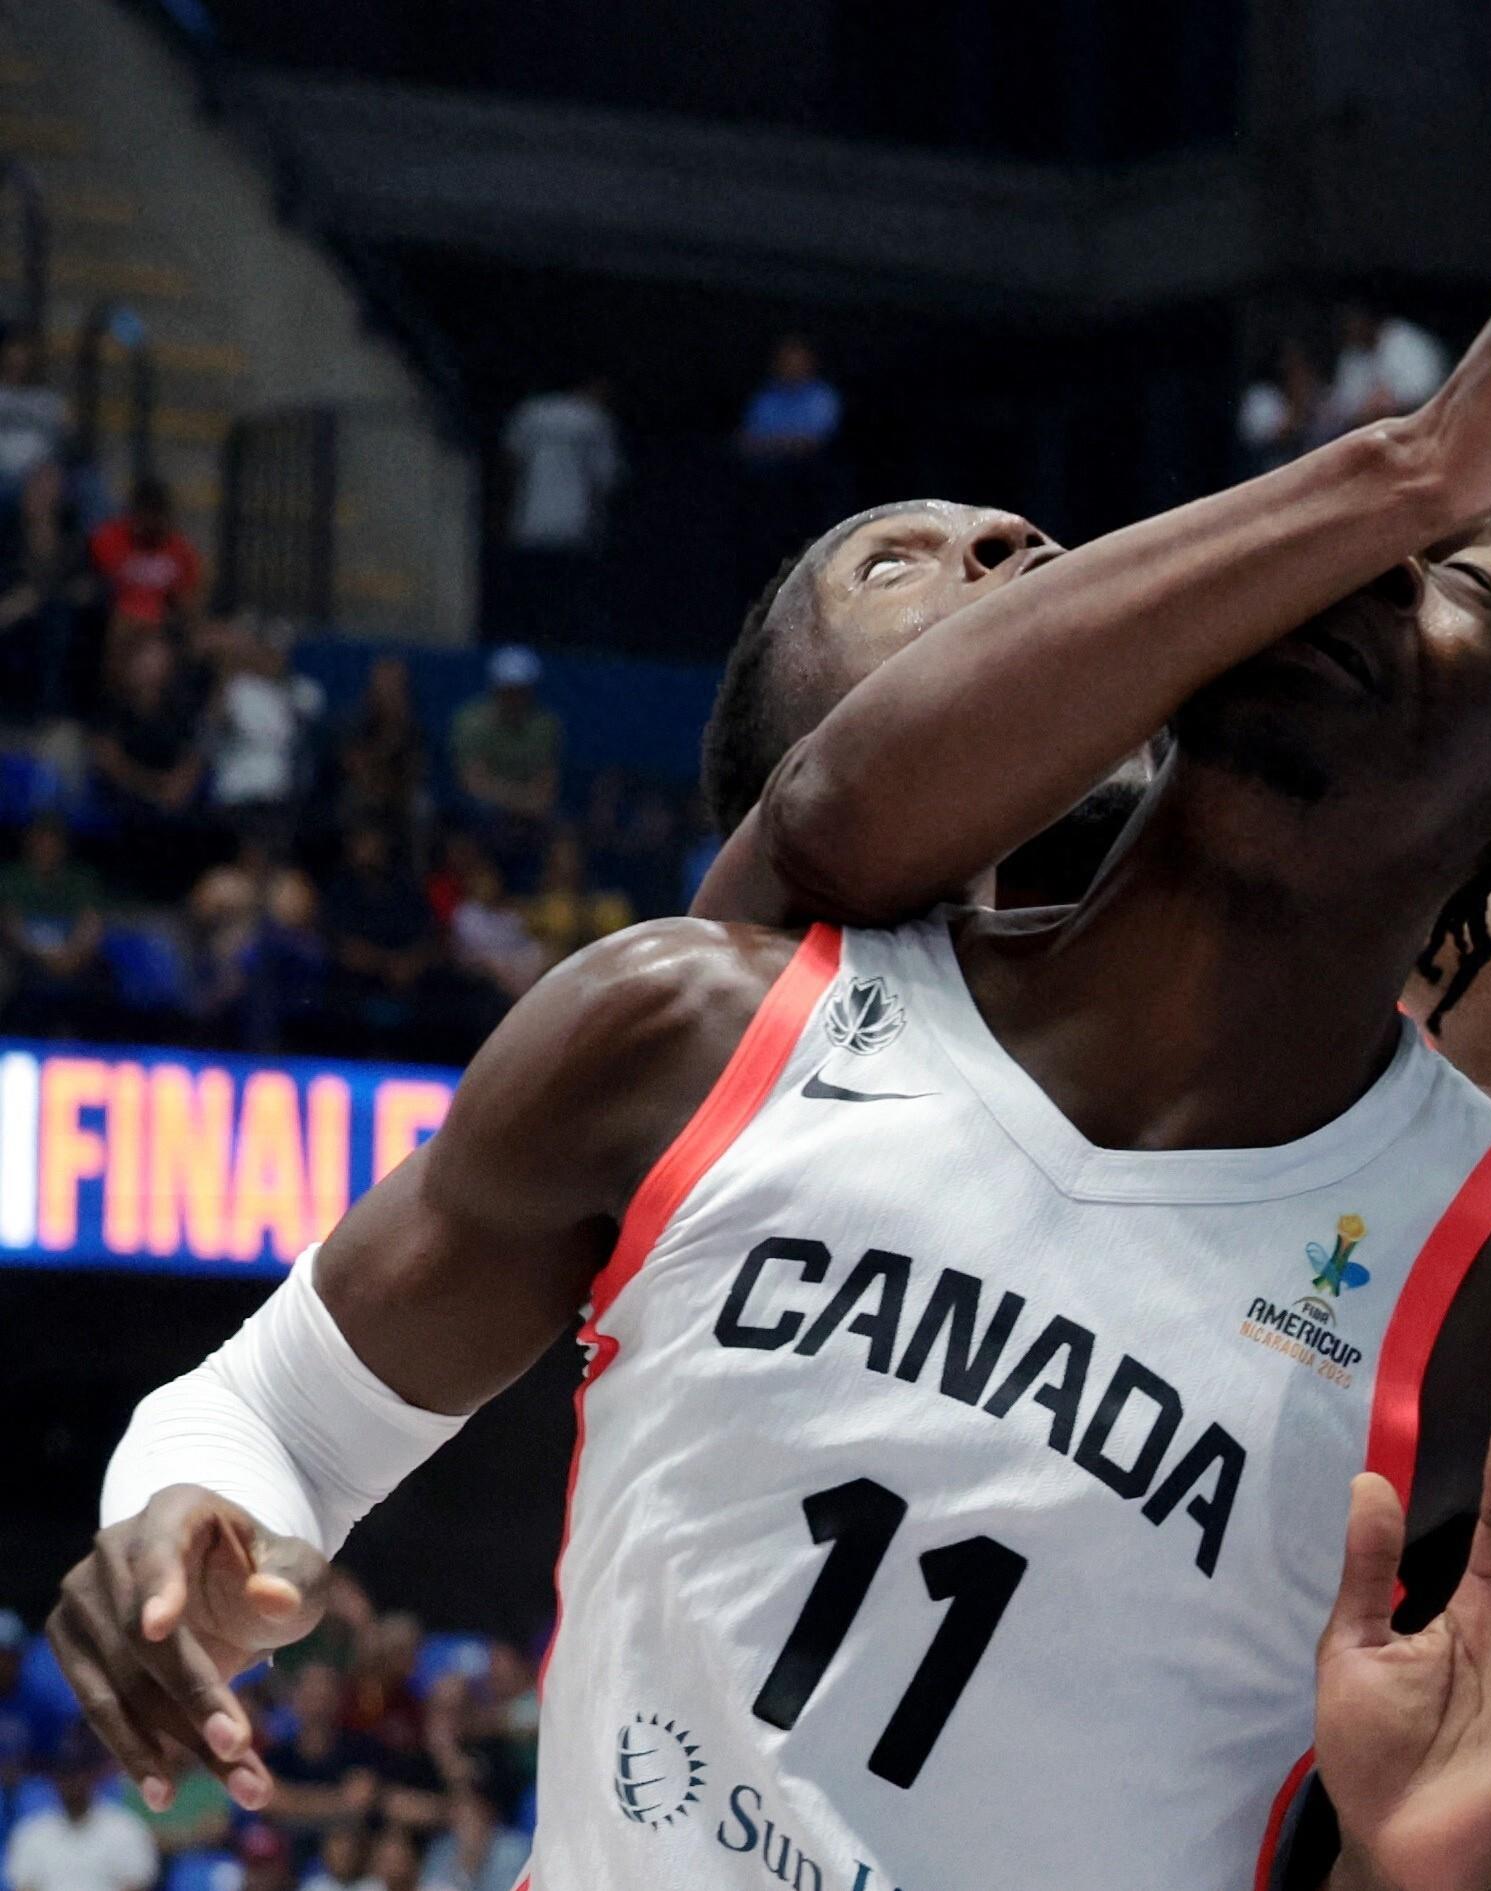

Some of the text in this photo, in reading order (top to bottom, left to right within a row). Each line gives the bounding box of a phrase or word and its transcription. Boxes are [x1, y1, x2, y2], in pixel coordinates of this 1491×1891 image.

[1239, 1320, 1316, 1367] NICARAGUA
[1247, 1297, 1363, 1368] AMERICUP
[714, 1236, 1247, 1579] CANADA
[751, 1477, 1028, 1790] 11
[717, 1785, 822, 1891] Sun
